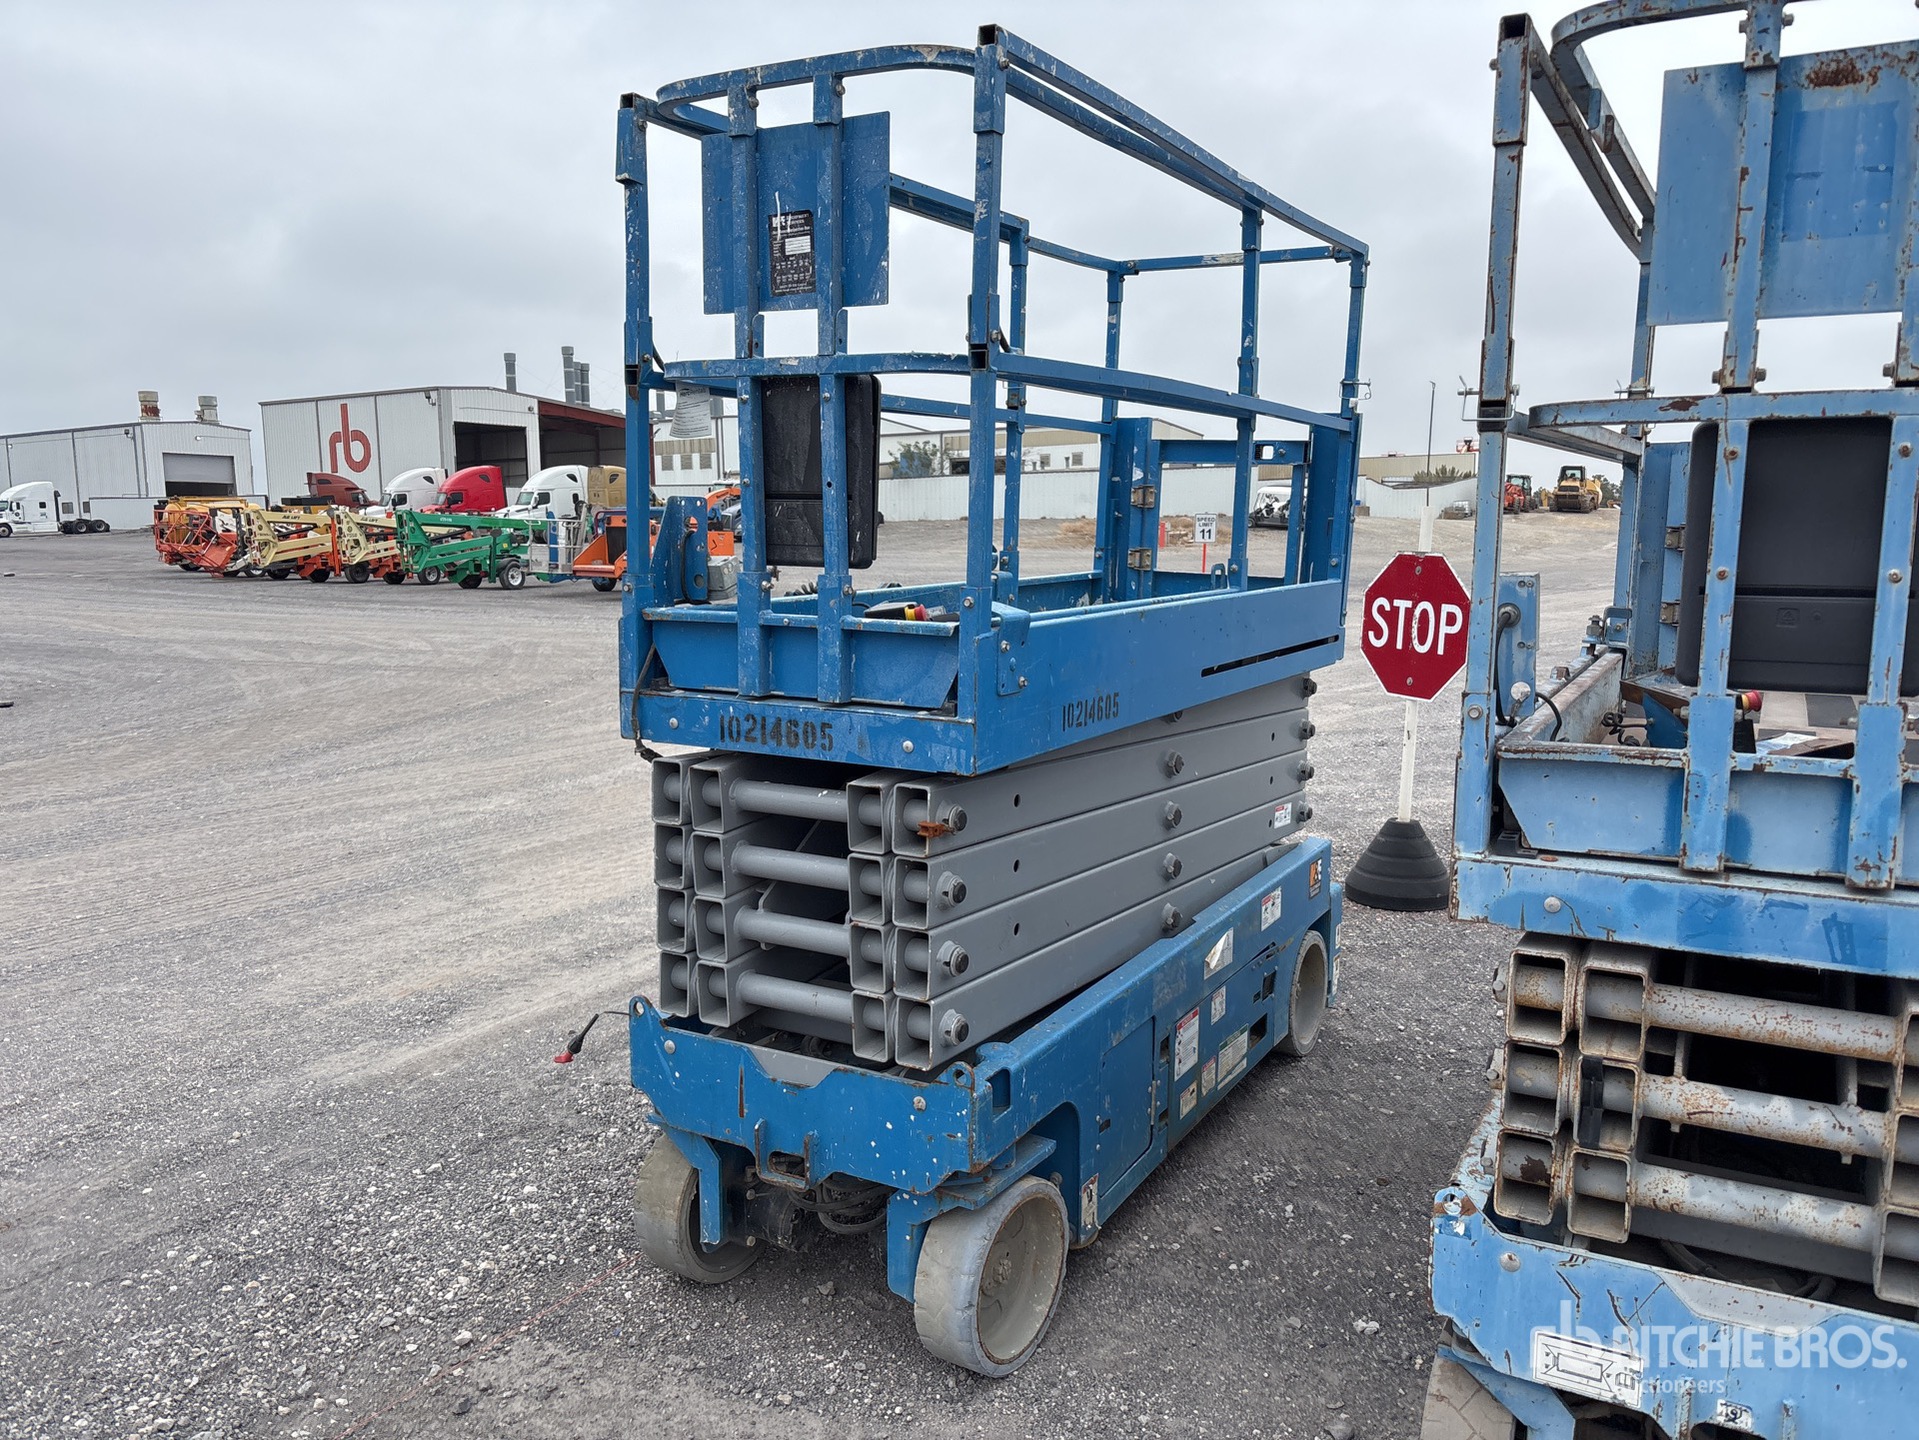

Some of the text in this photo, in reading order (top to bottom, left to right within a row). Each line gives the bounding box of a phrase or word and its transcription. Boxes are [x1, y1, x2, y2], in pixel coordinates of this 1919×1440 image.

[1200, 528, 1212, 539] 11
[1368, 597, 1463, 656] STOP
[1062, 692, 1120, 732] 10214605
[719, 713, 834, 752] 10214605
